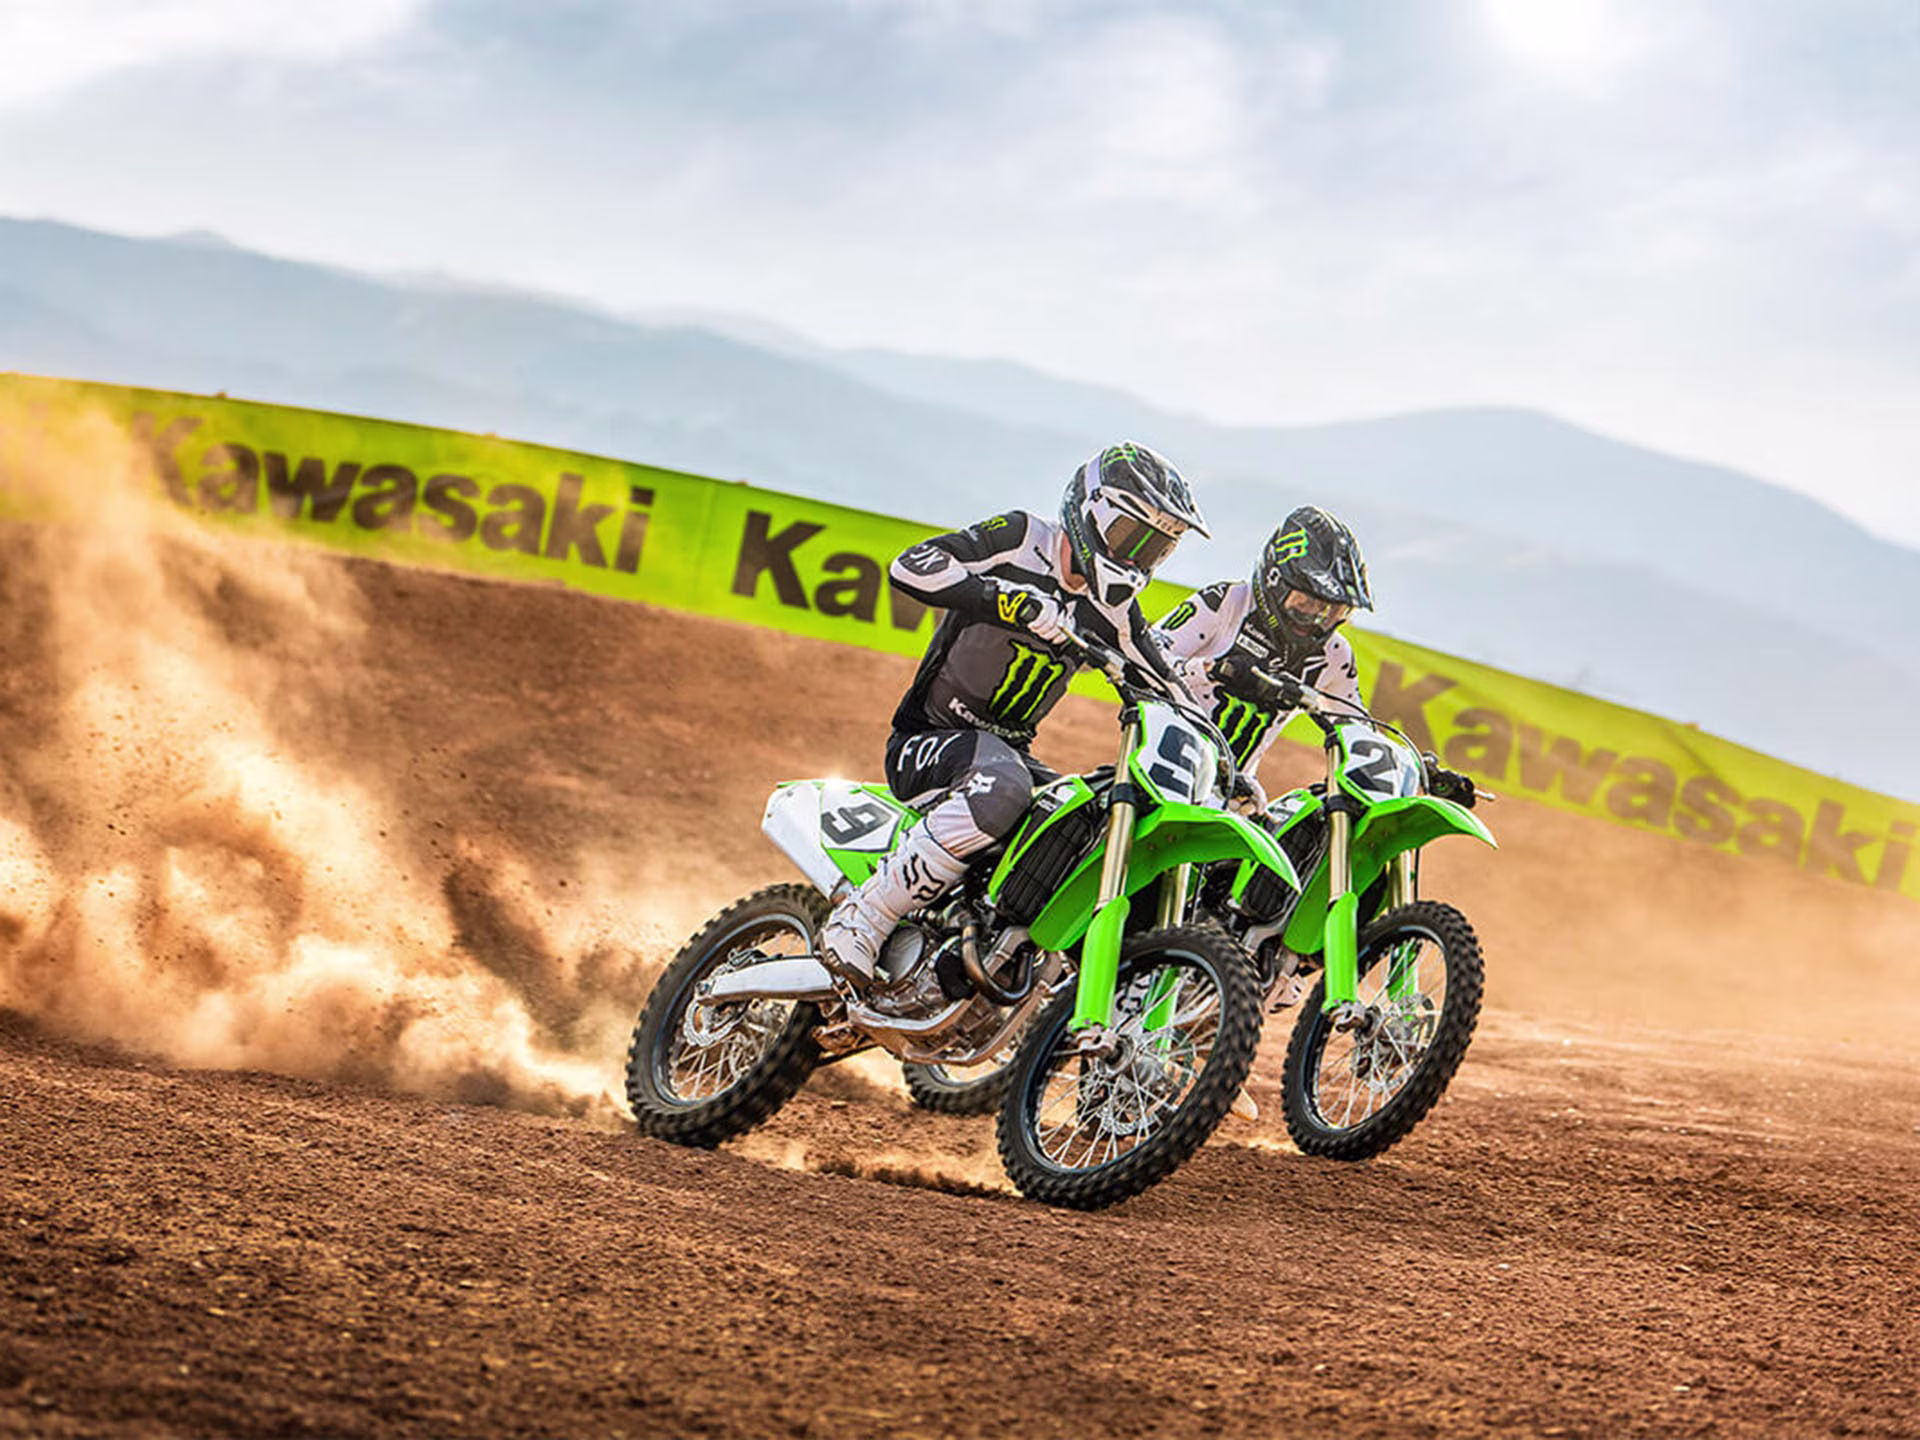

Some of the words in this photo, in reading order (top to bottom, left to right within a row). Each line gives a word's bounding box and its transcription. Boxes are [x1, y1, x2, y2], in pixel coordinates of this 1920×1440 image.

[131, 411, 655, 574] Kawasaki
[896, 732, 962, 772] FOX
[1368, 660, 1918, 890] Kawasaki
